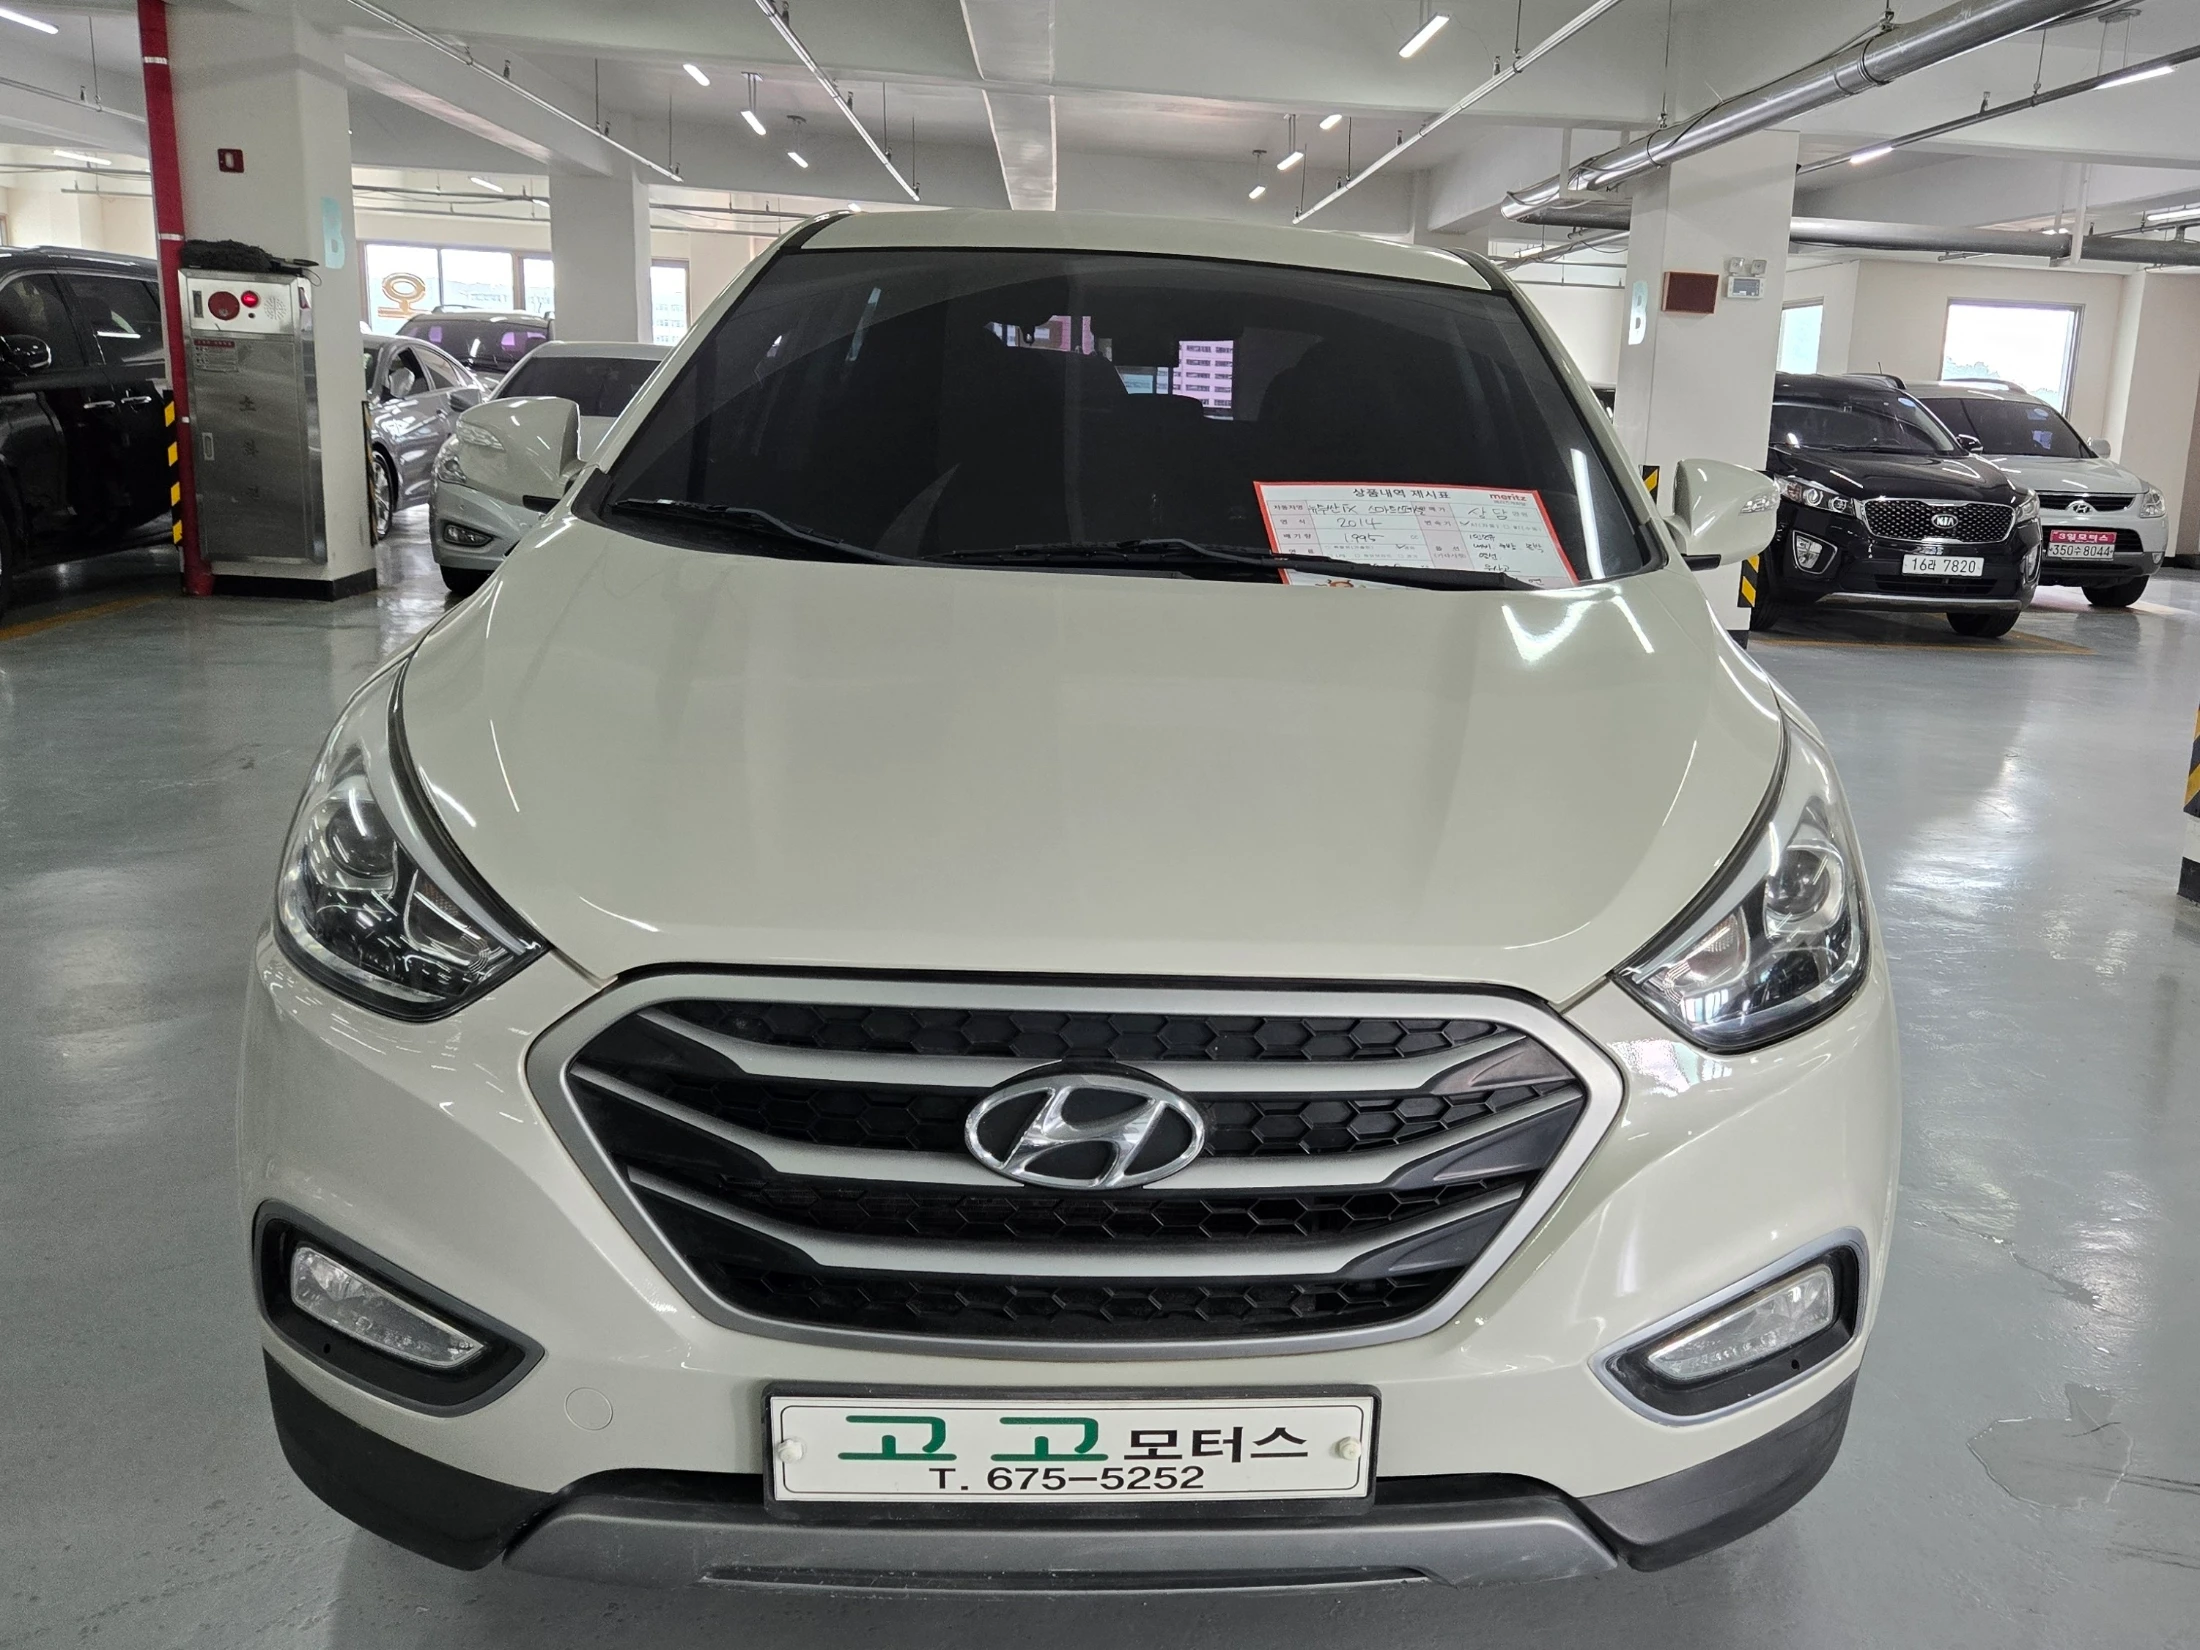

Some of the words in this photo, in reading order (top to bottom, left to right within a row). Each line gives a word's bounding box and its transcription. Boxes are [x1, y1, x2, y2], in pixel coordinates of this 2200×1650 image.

[320, 196, 346, 270] B
[1628, 279, 1649, 346] B
[1352, 488, 1407, 499] 상품내역
[1410, 489, 1451, 500] 제시표
[1489, 493, 1528, 502] meritz
[1336, 517, 1382, 530] 2014
[1936, 516, 1955, 526] KIA
[1912, 557, 1936, 571] 16라
[1943, 559, 1976, 573] 7820
[986, 1464, 1206, 1491] 675-5252
